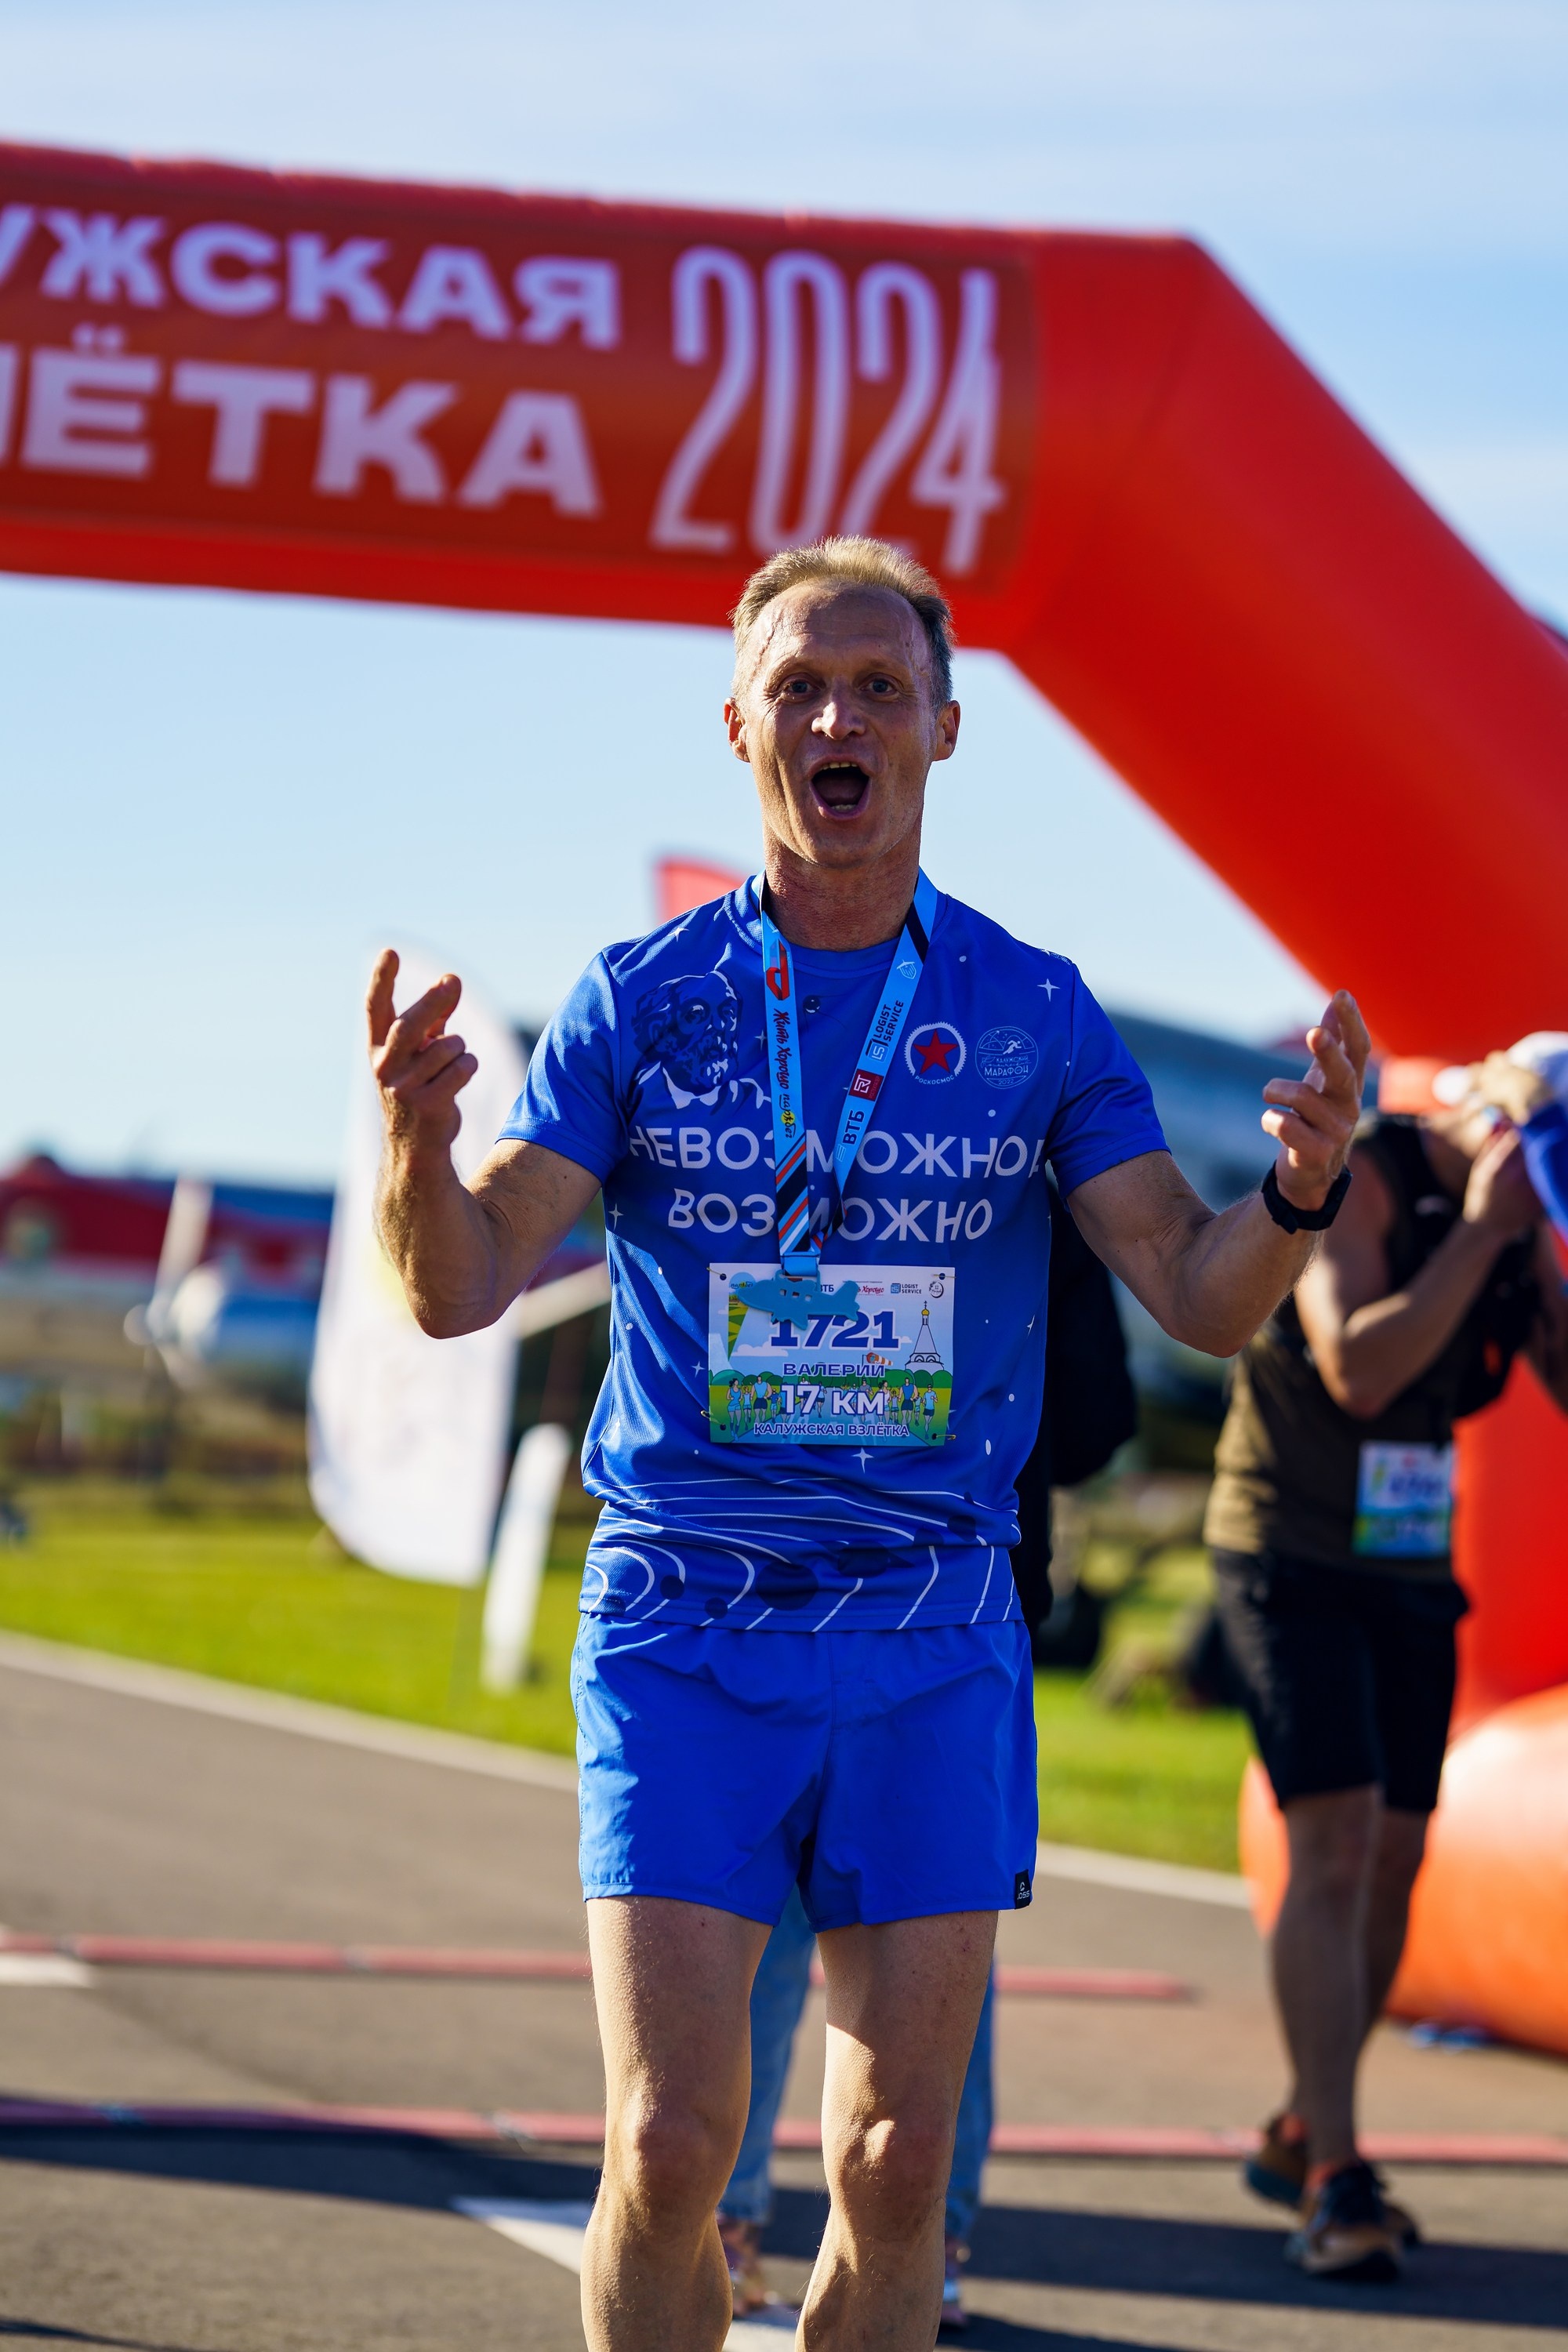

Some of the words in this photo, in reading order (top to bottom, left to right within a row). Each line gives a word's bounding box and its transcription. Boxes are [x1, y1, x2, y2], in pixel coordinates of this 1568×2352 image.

[0, 323, 600, 519] ЁТКА
[650, 245, 1005, 577] 2024
[773, 1007, 791, 1044] Жить
[873, 1004, 891, 1039] LOGIST
[883, 1000, 904, 1042] SERVICE
[775, 1044, 793, 1090] Хорошо
[914, 1075, 955, 1085] РОСКОСМОС
[984, 1065, 1029, 1076] МАРАФОН
[842, 1109, 865, 1145] ВТБ
[770, 1310, 900, 1349] 1721
[783, 1361, 885, 1377] ВАЛЕРИЙ
[781, 1384, 822, 1414] 17
[753, 1422, 844, 1436] КАЛУЖСКАЯ
[848, 1422, 909, 1436] ВЗЛЁТКА
